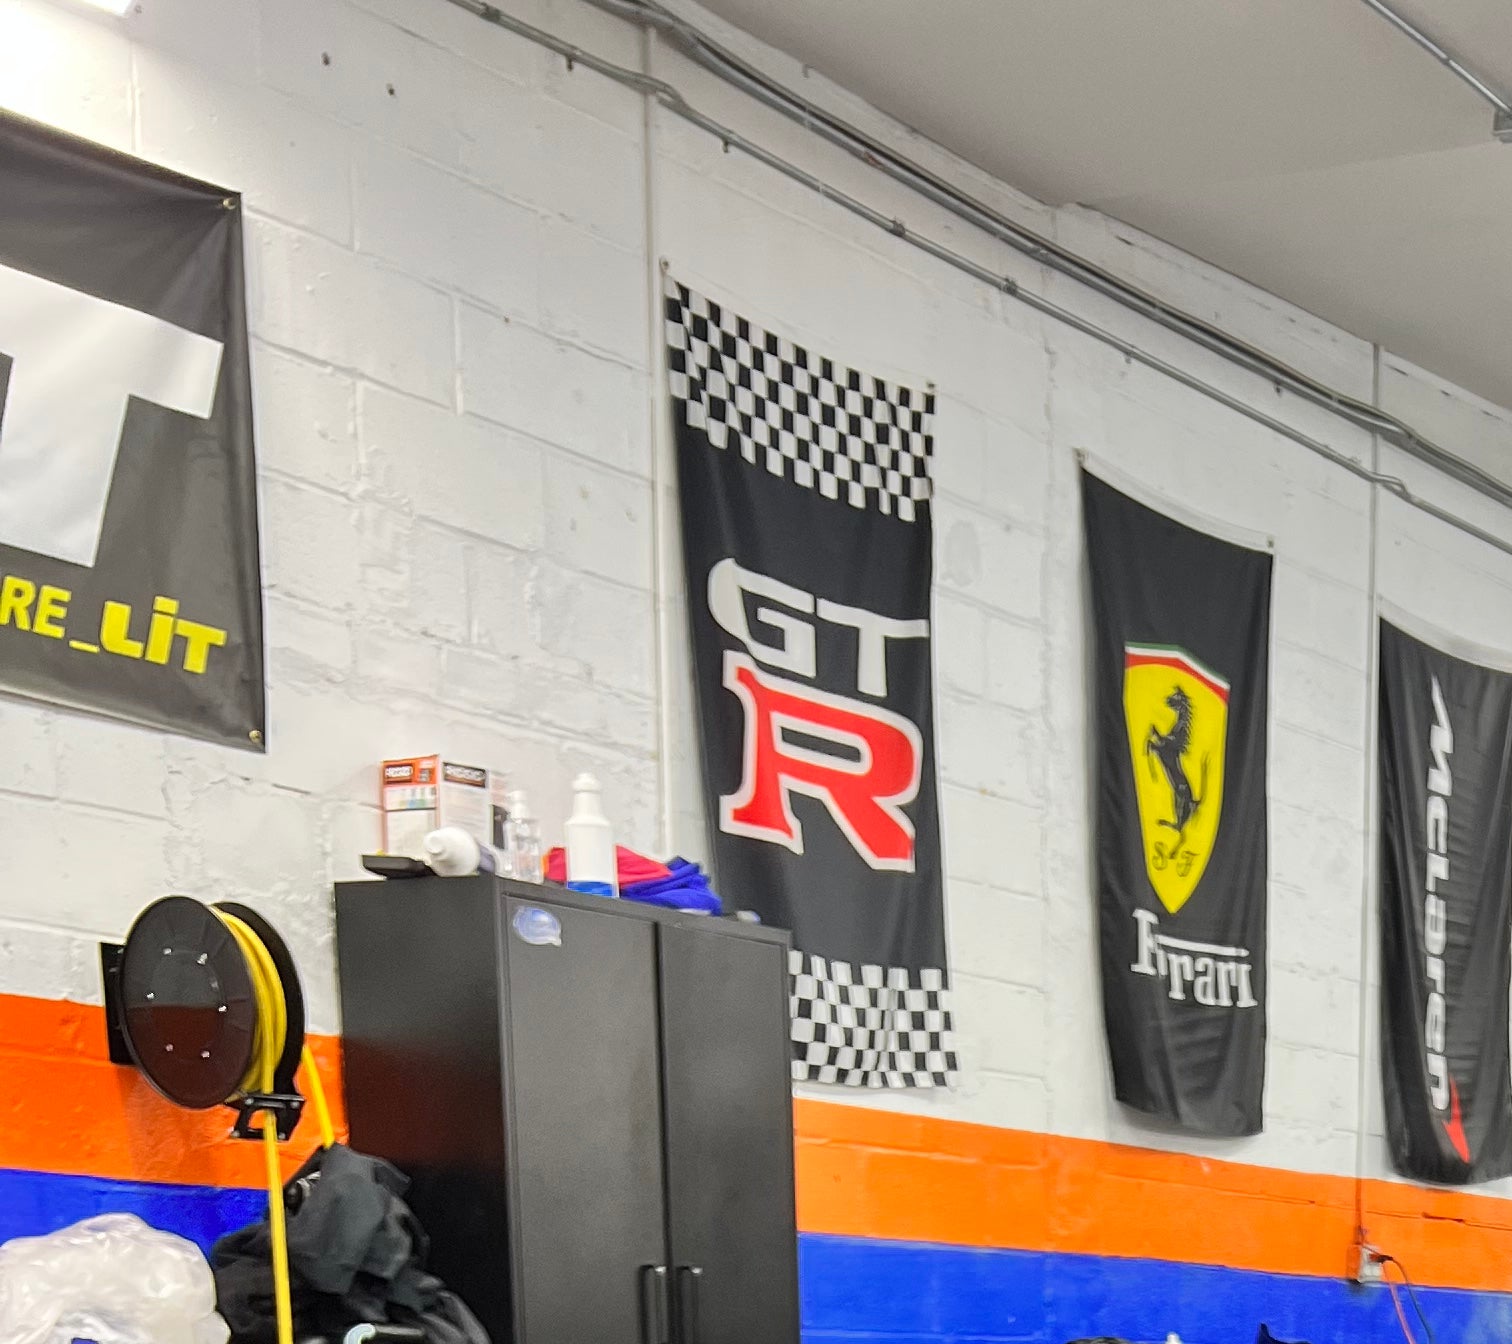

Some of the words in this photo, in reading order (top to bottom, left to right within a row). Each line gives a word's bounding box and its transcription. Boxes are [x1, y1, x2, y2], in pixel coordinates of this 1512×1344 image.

[708, 557, 929, 698] GT
[719, 648, 924, 873] R
[1130, 908, 1258, 1008] Frari
